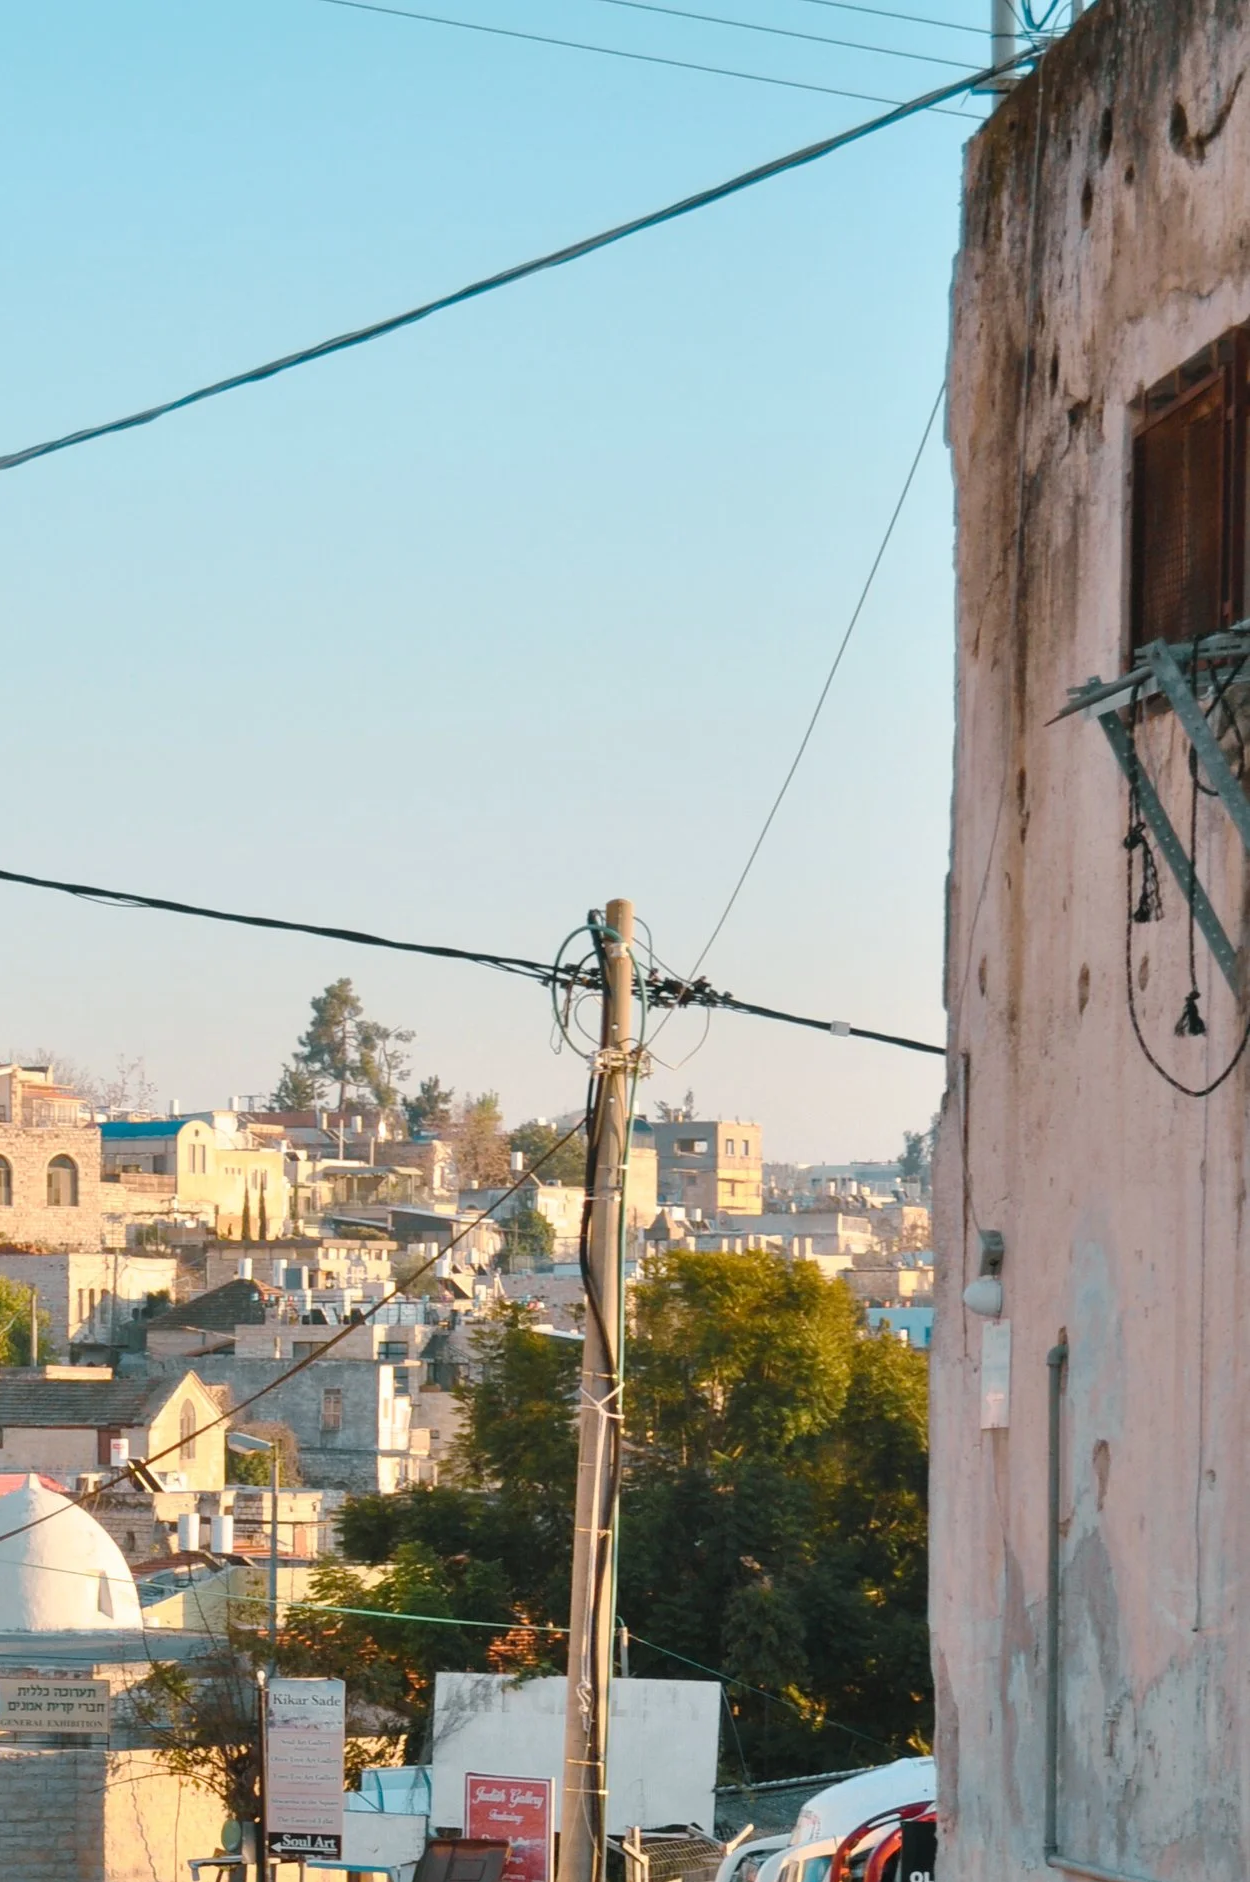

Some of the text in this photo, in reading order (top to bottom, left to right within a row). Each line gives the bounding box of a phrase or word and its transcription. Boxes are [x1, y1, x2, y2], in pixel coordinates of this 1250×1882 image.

[17, 1684, 97, 1698] תערוכה כללית
[7, 1701, 44, 1712] אמנים
[78, 1701, 106, 1713] חברי
[273, 1693, 342, 1707] Kikar Sade
[46, 1701, 75, 1715] קרית
[0, 1719, 44, 1728] GENERAL
[48, 1720, 103, 1729] EXHIBITION
[282, 1834, 336, 1849] Soul Art
